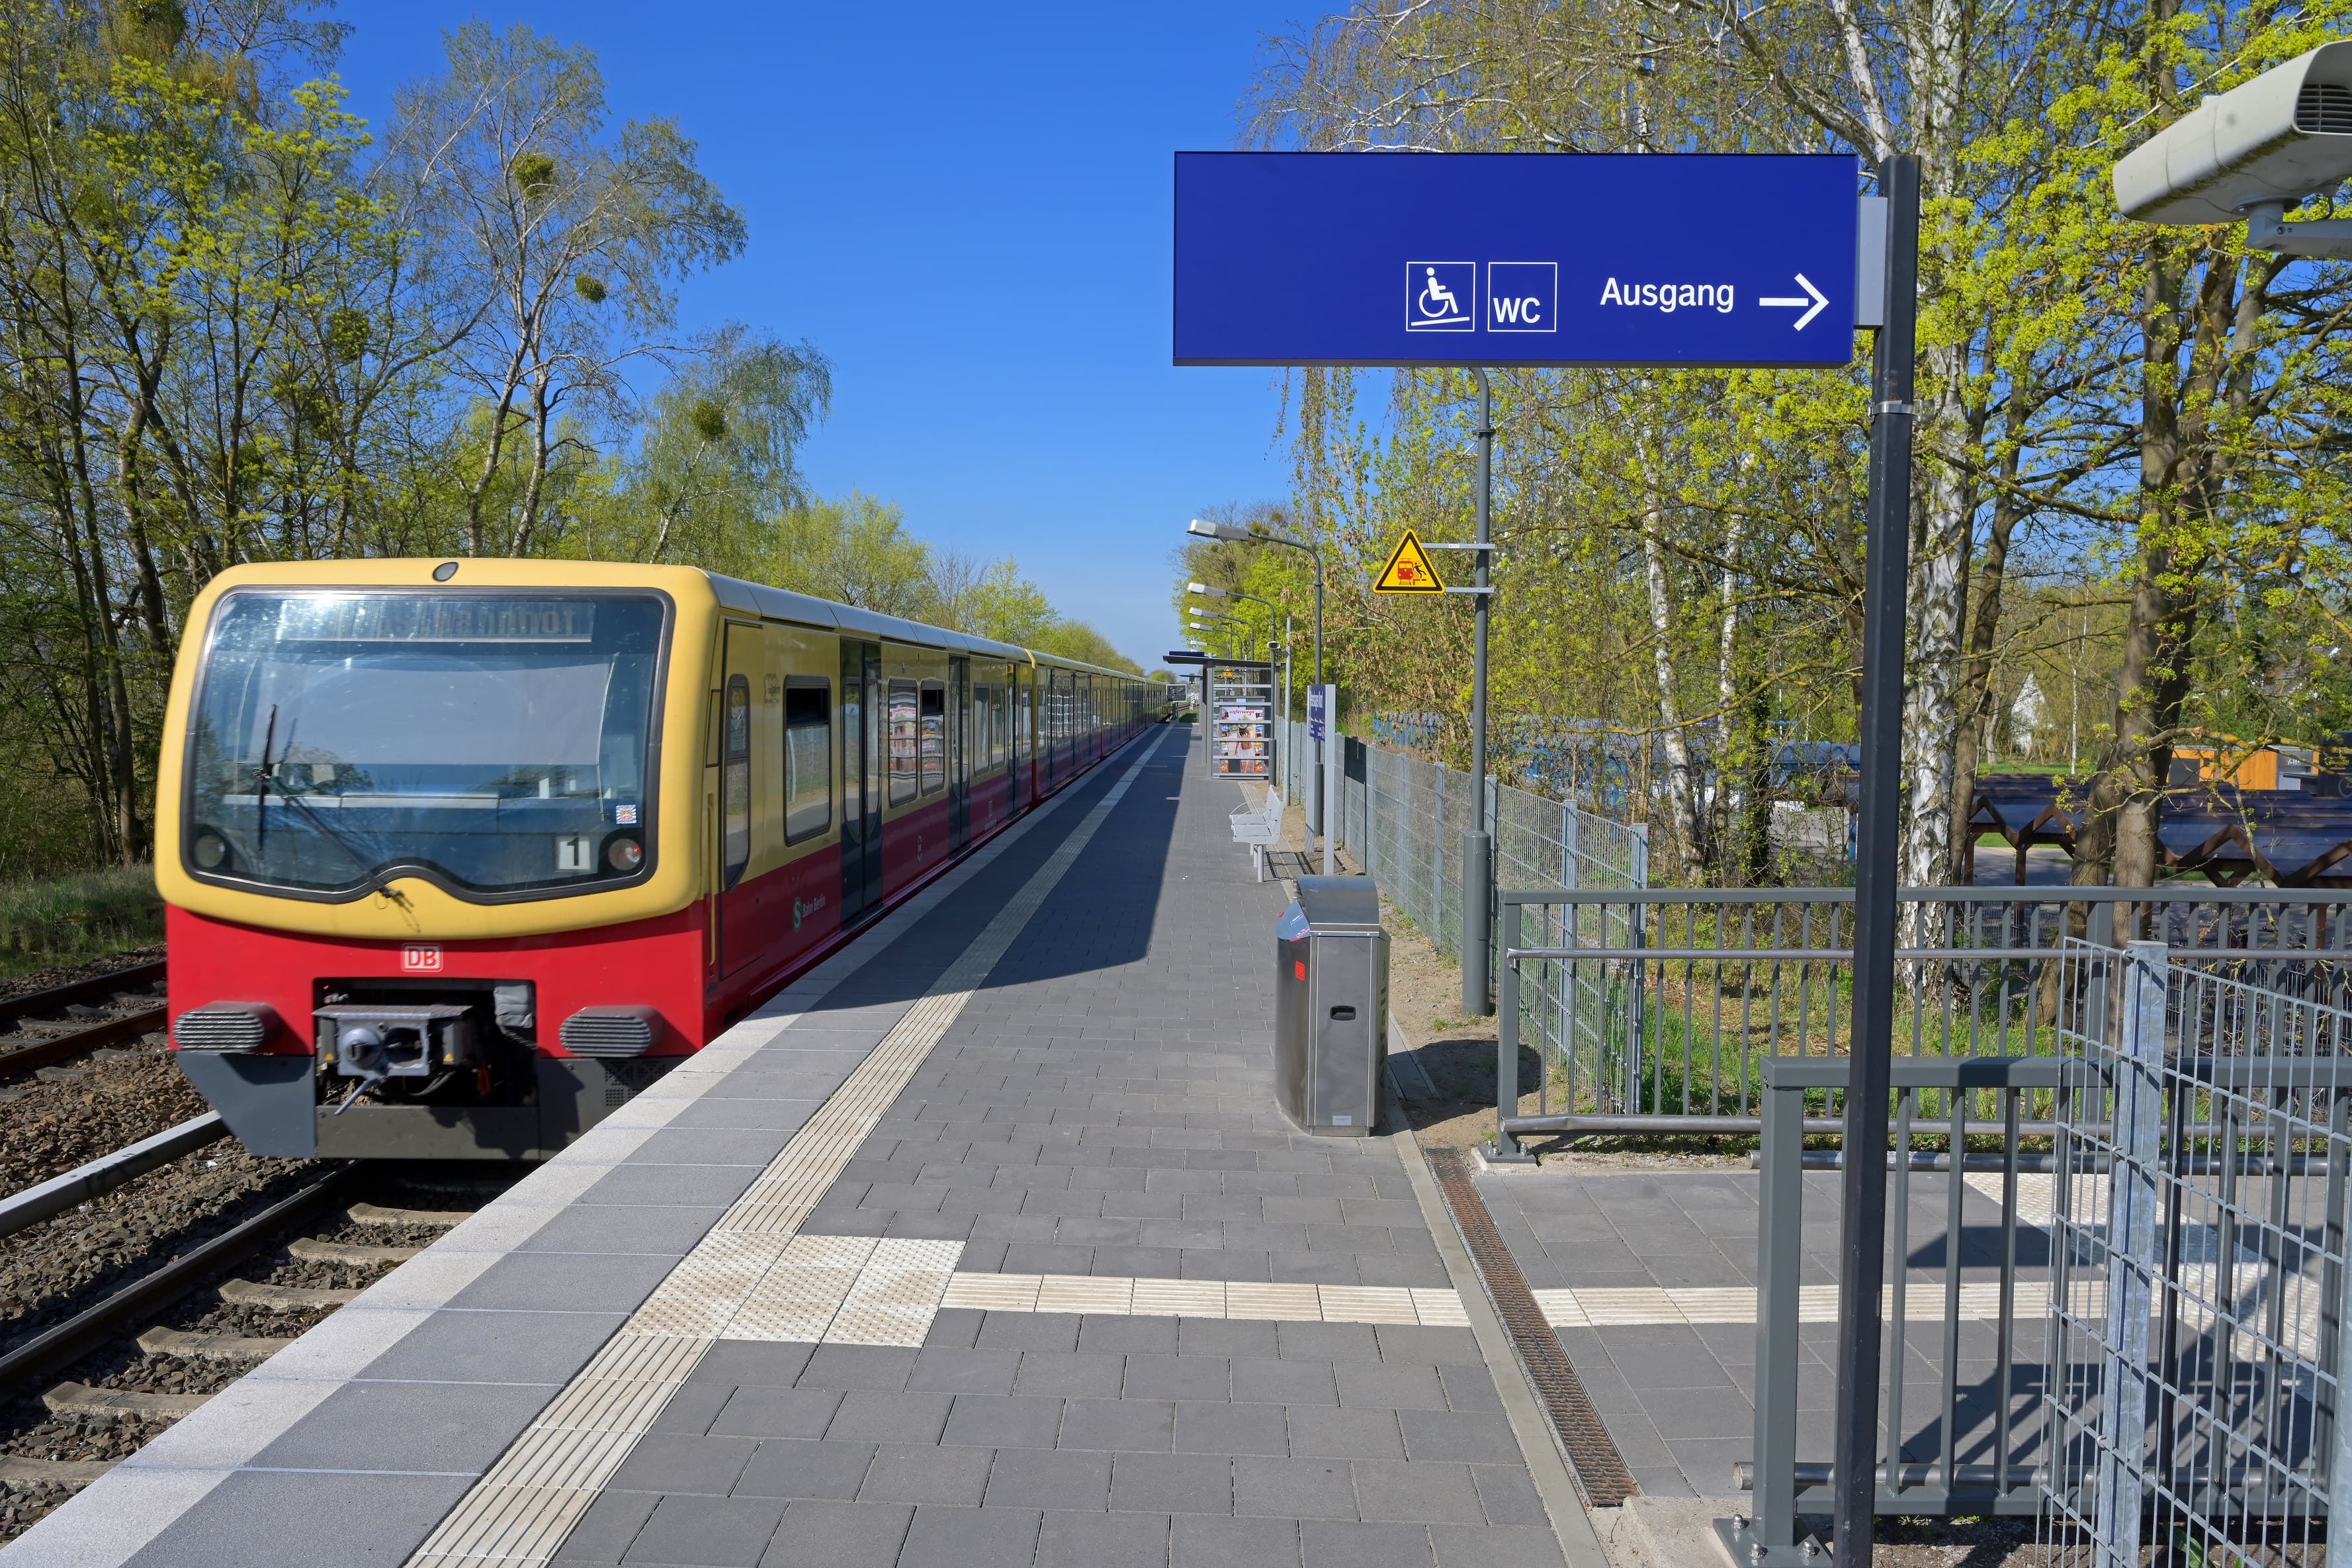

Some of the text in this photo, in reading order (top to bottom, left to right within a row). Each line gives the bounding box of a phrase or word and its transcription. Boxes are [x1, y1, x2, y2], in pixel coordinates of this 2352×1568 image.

[1600, 278, 1734, 313] Ausgang
[1493, 297, 1541, 323] WC
[567, 837, 580, 866] 1
[409, 949, 437, 966] DB
